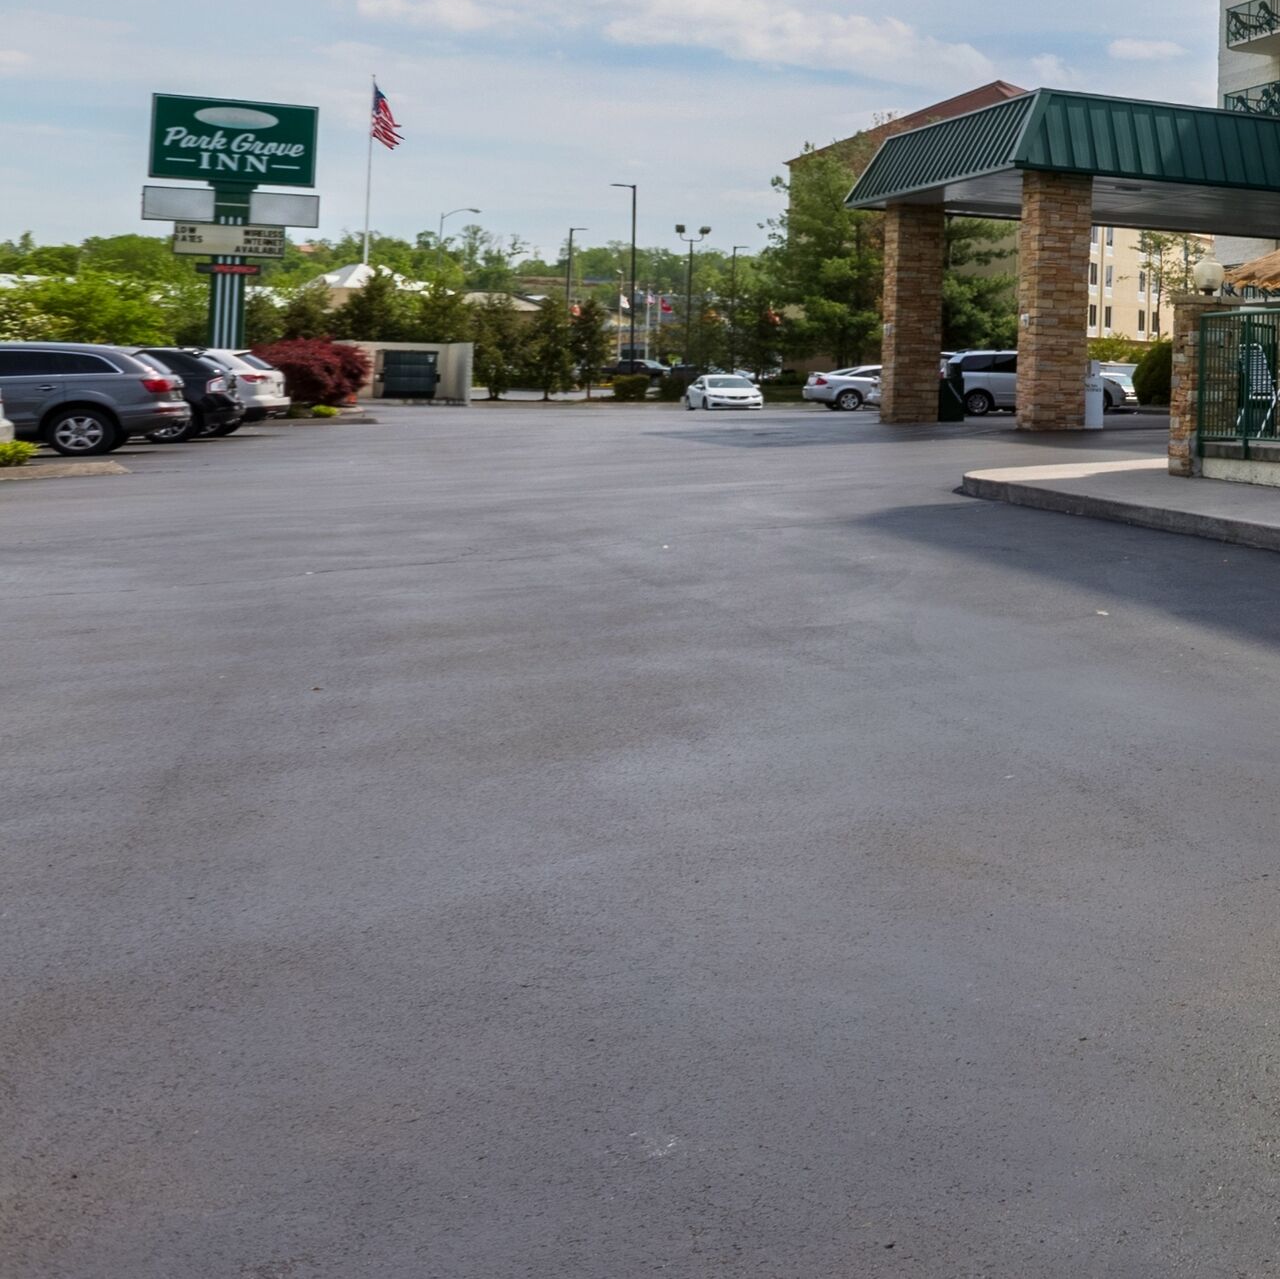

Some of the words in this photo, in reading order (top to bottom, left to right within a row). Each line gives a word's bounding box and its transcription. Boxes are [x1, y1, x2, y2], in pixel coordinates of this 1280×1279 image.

[163, 126, 228, 150] Park
[230, 133, 305, 157] Grove
[198, 151, 270, 173] INN
[175, 226, 196, 234] LOW
